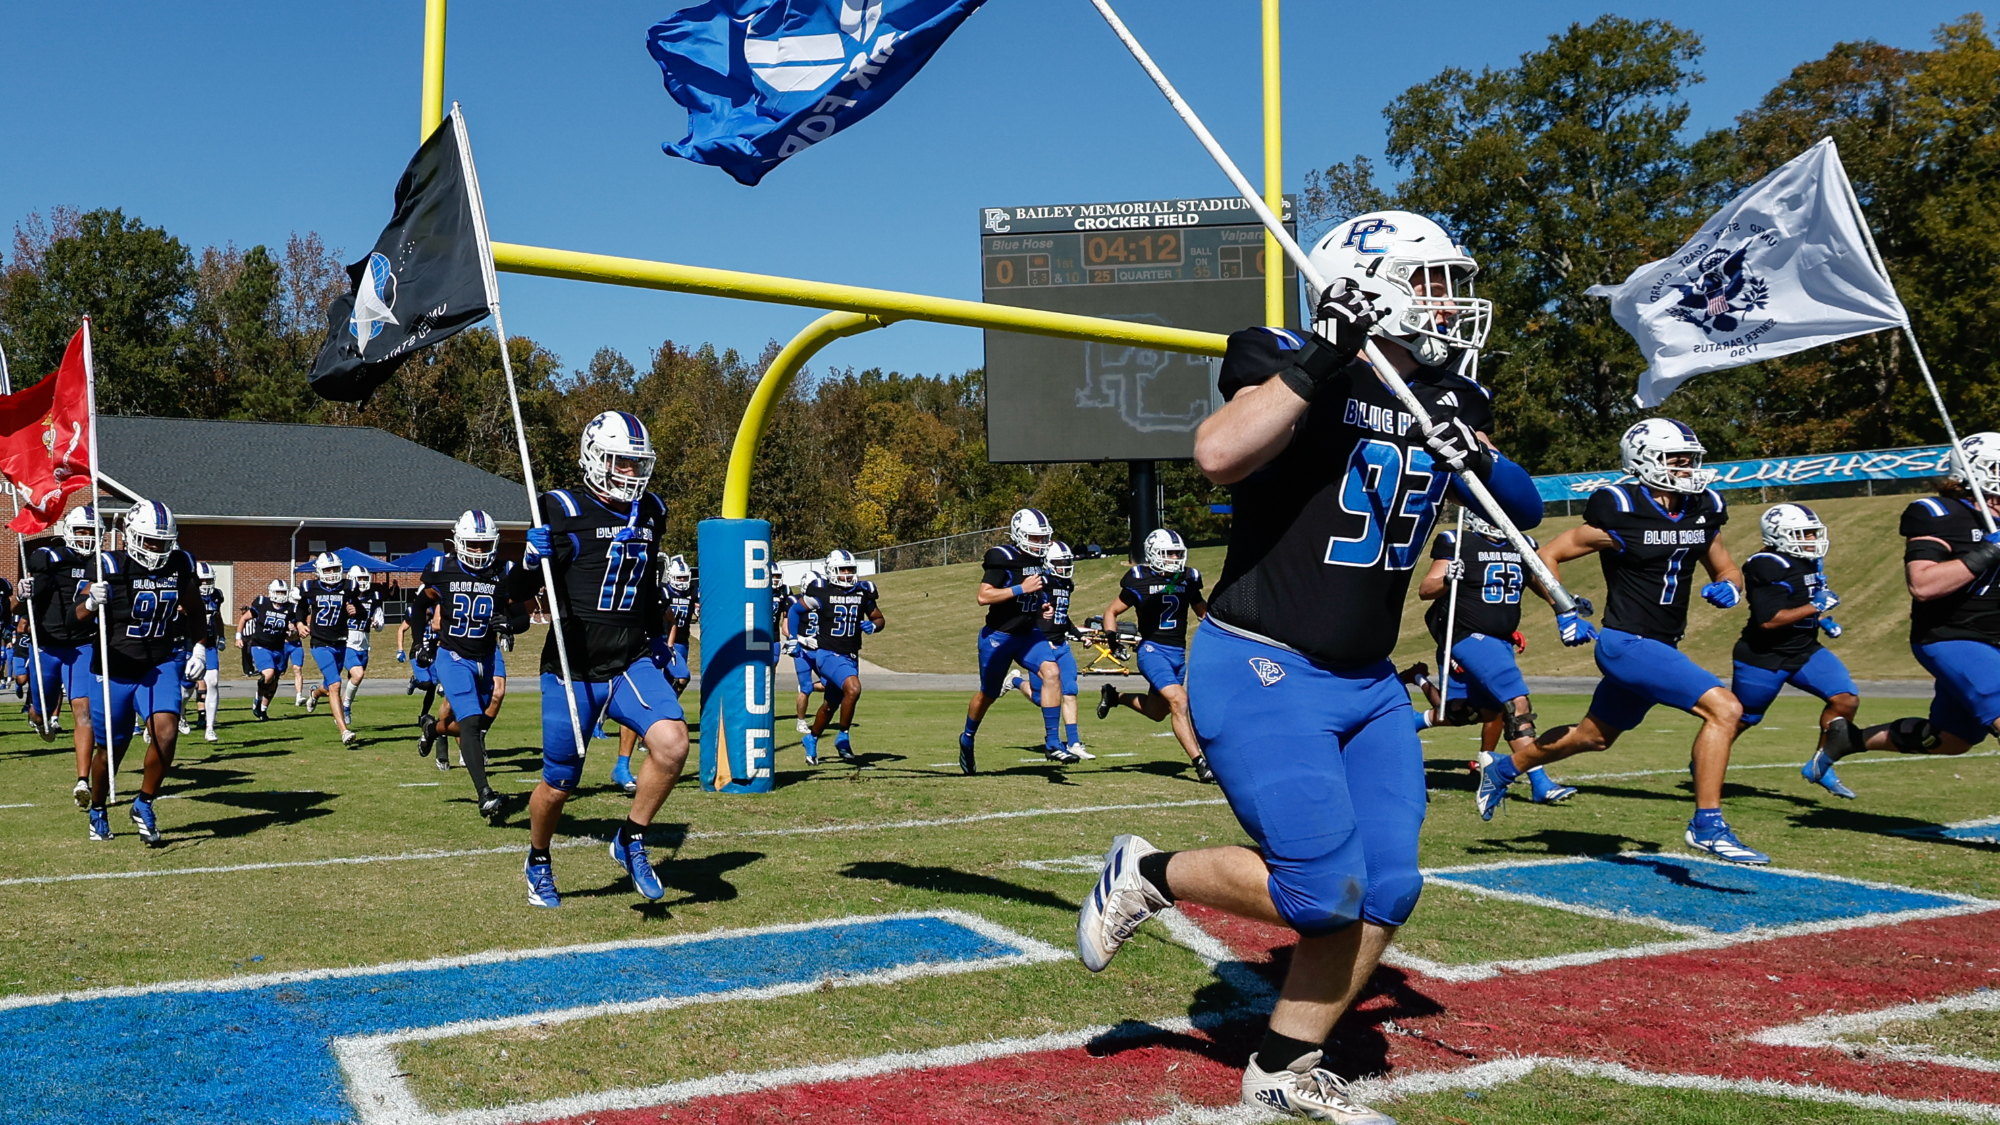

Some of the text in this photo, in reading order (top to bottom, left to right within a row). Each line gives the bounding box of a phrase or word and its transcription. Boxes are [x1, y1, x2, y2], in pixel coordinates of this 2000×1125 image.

[1016, 206, 1076, 220] BAILEY
[1080, 201, 1174, 217] MEMORIAL
[1074, 213, 1200, 230] CROCKER FIELD
[992, 238, 1054, 250] Blue Hose
[1221, 229, 1265, 242] Valpara
[1088, 234, 1177, 263] 04:12
[1190, 247, 1212, 256] BALL
[1056, 258, 1074, 269] 1st
[1195, 257, 1208, 266] ON
[996, 260, 1014, 283] 0
[1041, 273, 1048, 282] 3
[1065, 272, 1080, 283] 10
[1094, 271, 1111, 282] 25
[1119, 269, 1172, 281] QUARTER
[1193, 266, 1211, 278] 35
[1343, 398, 1394, 435] BLUE
[1324, 438, 1451, 571] 93
[1643, 529, 1706, 545] BLUE HOSE
[133, 579, 156, 591] BLUE
[597, 541, 648, 611] 17
[1482, 562, 1523, 604] 63
[1659, 547, 1690, 605] 1
[450, 581, 496, 595] BLUE HOSE
[126, 590, 178, 638] 97
[316, 600, 343, 627] 27
[449, 593, 494, 638] 39
[830, 605, 858, 637] 31
[1159, 595, 1179, 629] 2
[744, 539, 771, 778] BLUE
